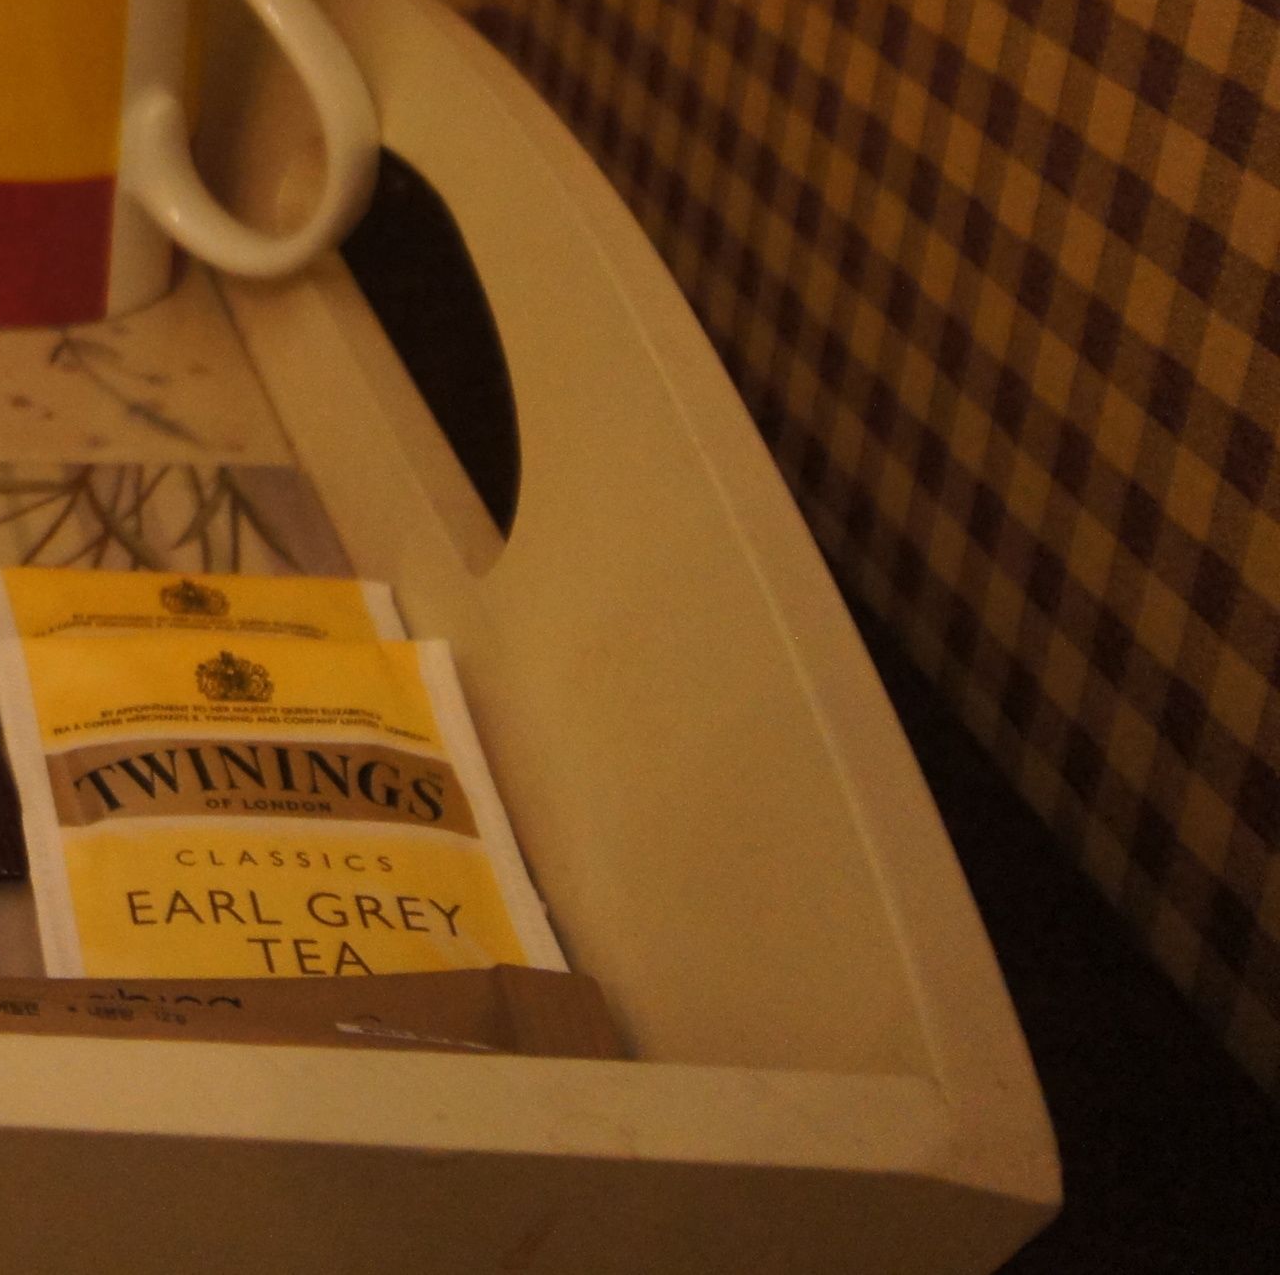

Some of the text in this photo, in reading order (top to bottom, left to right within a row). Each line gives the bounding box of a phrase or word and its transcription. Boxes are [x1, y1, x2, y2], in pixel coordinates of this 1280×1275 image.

[73, 745, 445, 822] TWININGS
[205, 798, 332, 813] OF LONDON
[176, 849, 393, 872] CLASSICS
[127, 890, 462, 937] EARL GREY
[247, 938, 374, 975] TEA
